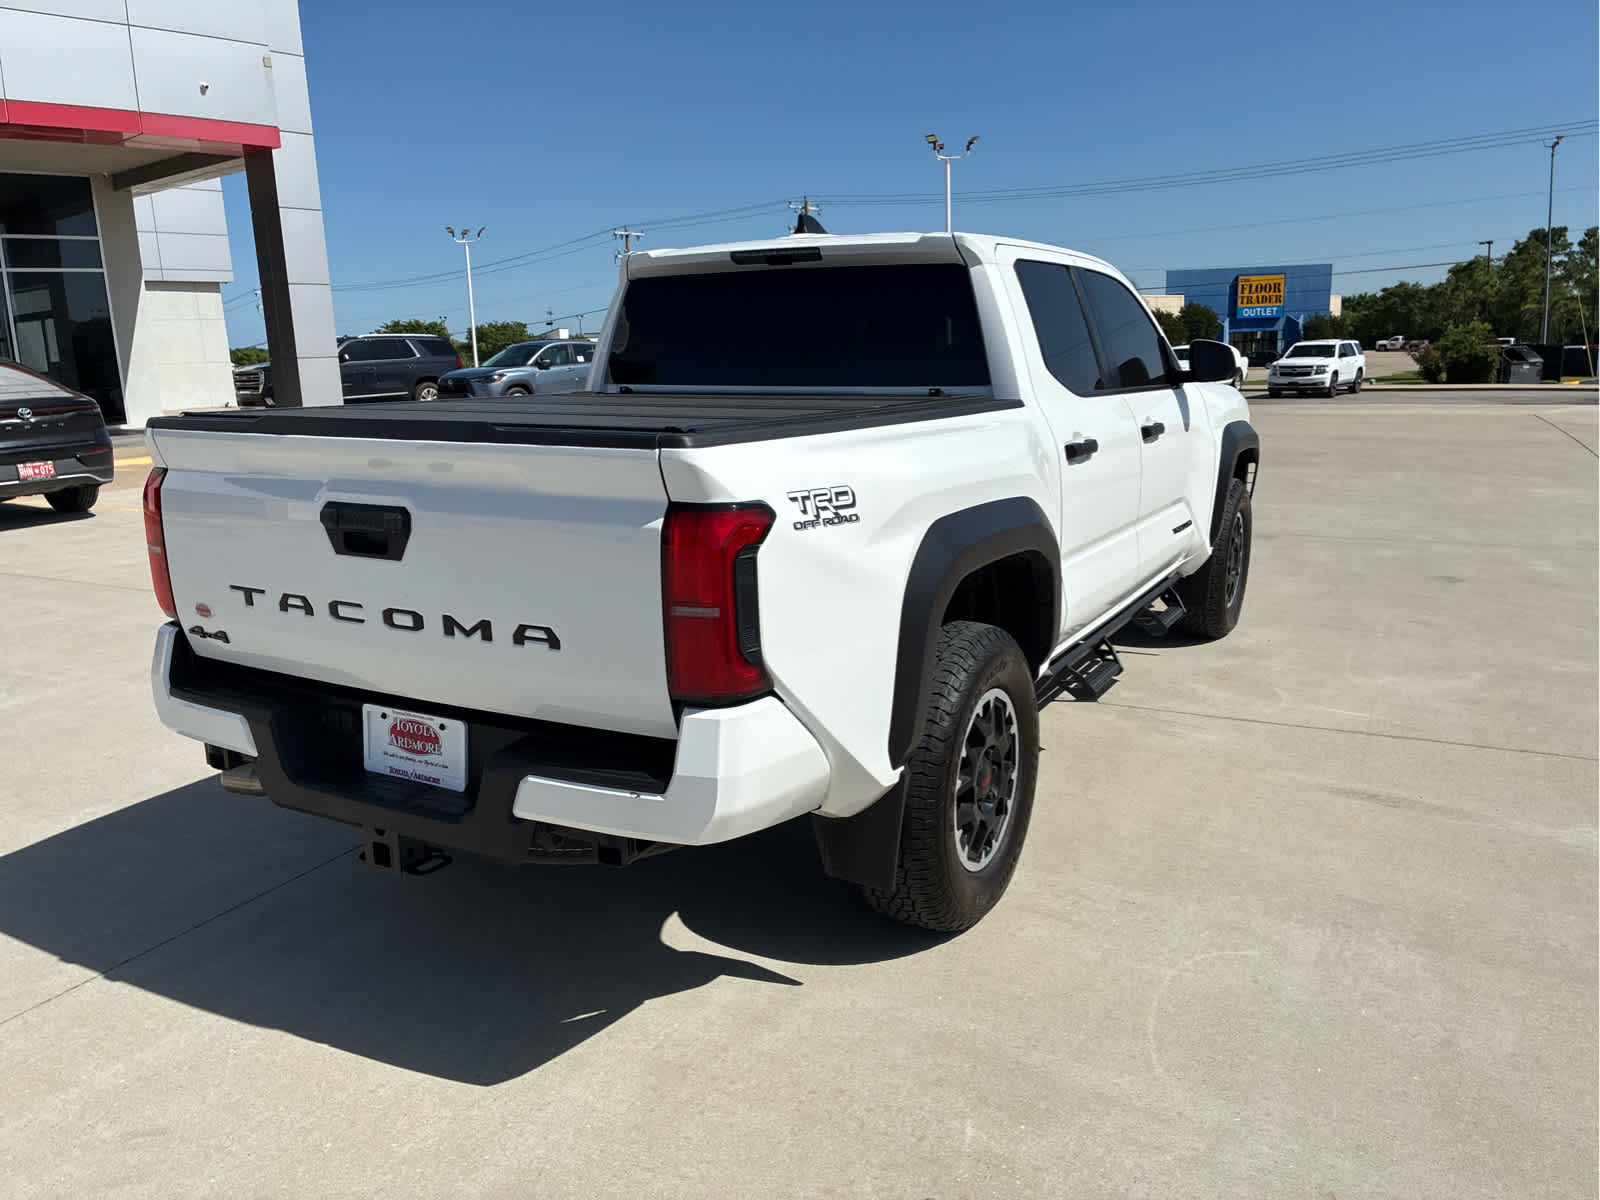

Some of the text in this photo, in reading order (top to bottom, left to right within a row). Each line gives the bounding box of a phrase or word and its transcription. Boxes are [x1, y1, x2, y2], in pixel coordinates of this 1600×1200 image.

[1240, 282, 1281, 295] FLOOR
[1239, 294, 1282, 304] TRADER
[1242, 307, 1277, 317] OUTLET
[786, 485, 857, 520] TRD
[793, 513, 861, 531] OFF ROAD
[229, 584, 562, 651] TACOMA
[393, 717, 437, 738] TOYOTA
[388, 733, 442, 755] ARDMORE
